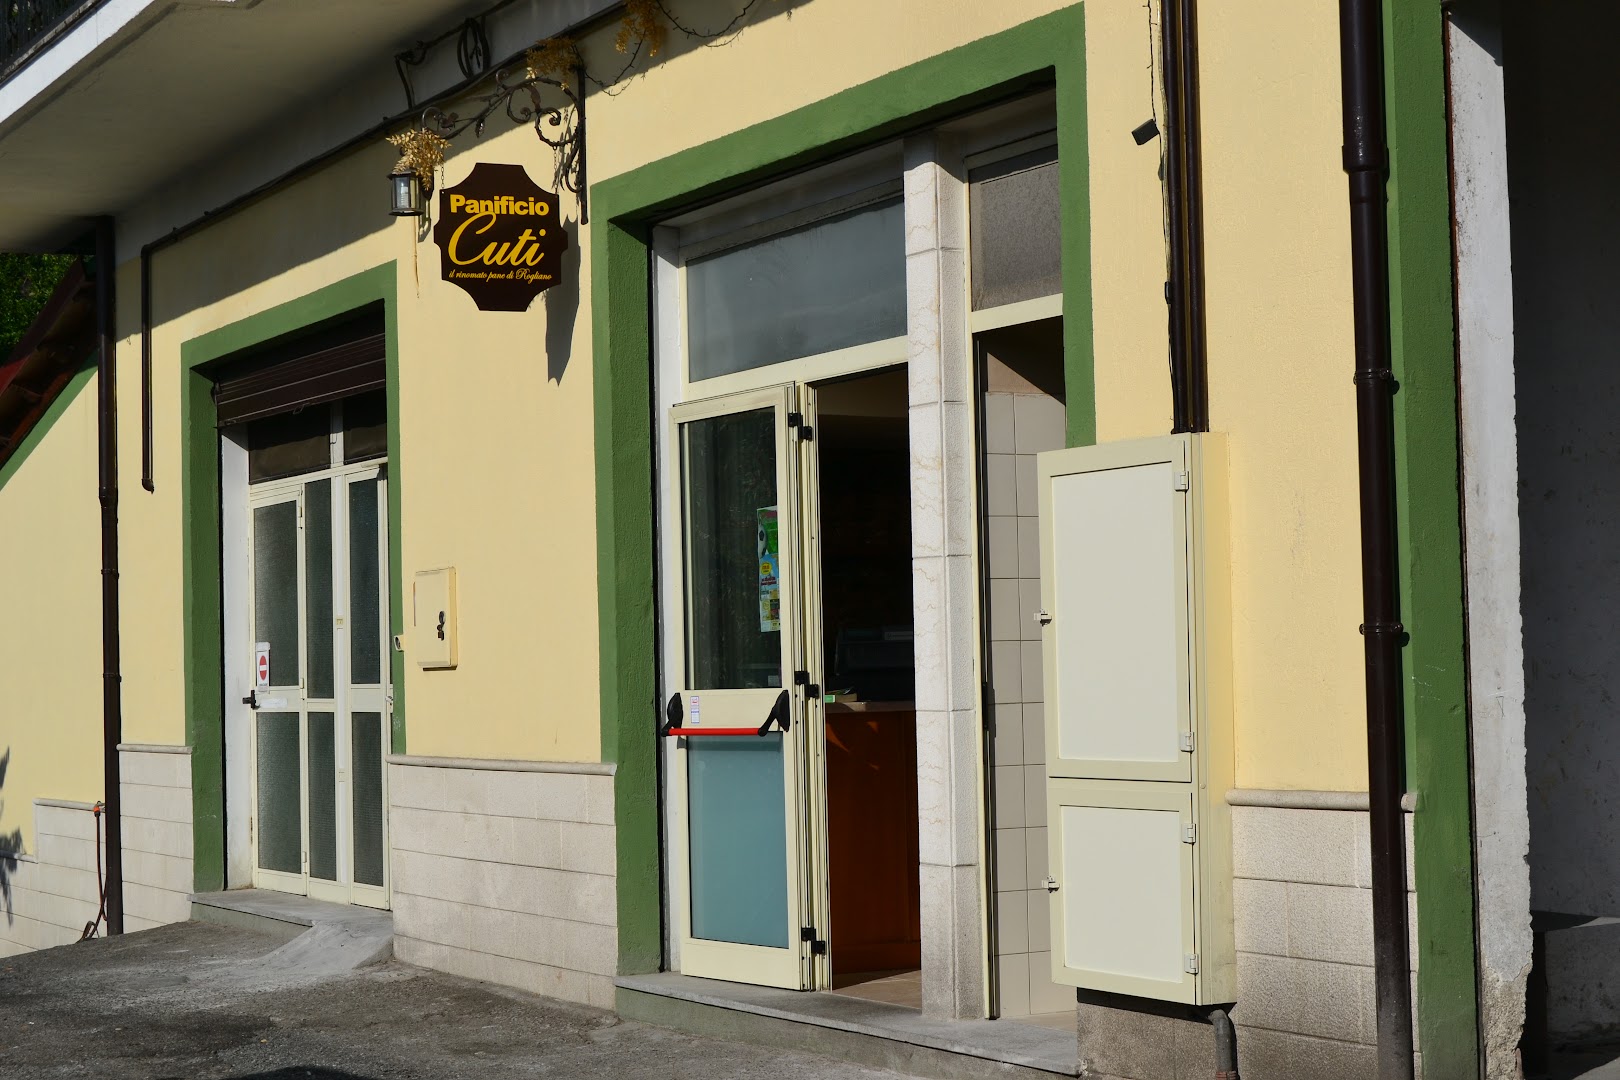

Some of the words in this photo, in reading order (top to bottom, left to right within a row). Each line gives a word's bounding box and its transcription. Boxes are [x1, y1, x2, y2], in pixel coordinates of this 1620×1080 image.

[450, 194, 550, 216] Panificio
[448, 210, 547, 267] Cuti
[448, 269, 456, 279] il
[456, 270, 487, 279] rinomato
[486, 271, 506, 282] pane
[506, 270, 514, 279] di
[515, 268, 552, 284] Rogliano
